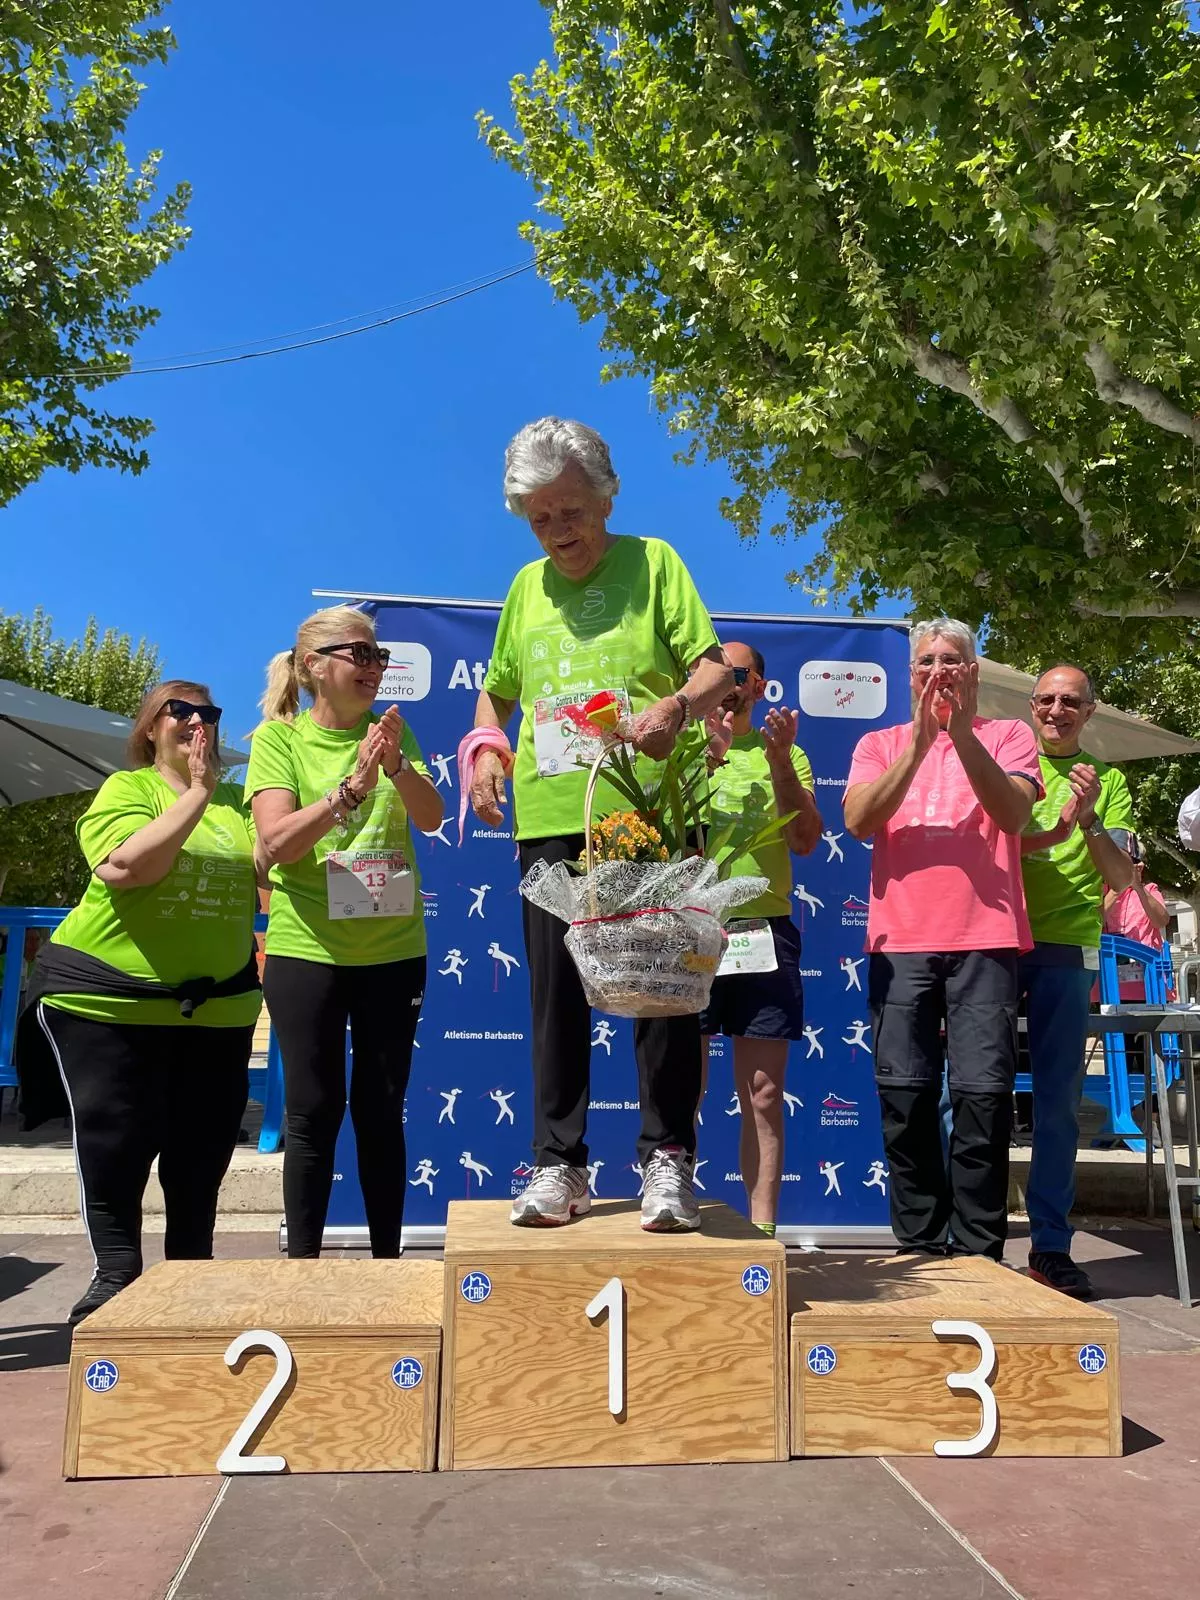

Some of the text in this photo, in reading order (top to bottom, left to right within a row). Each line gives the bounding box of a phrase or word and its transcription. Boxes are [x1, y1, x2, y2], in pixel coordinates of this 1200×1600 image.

[384, 673, 415, 682] tletismo
[816, 777, 848, 786] Barbastr
[472, 829, 510, 839] Atletismo
[366, 872, 387, 887] 13
[841, 917, 868, 926] Barbas
[444, 1030, 524, 1040] Atletismo Barbastro
[588, 1101, 623, 1110] tletismo
[821, 1116, 859, 1126] Barbastro
[585, 1276, 623, 1415] 1
[931, 1320, 997, 1456] 3
[216, 1329, 293, 1474] 2
